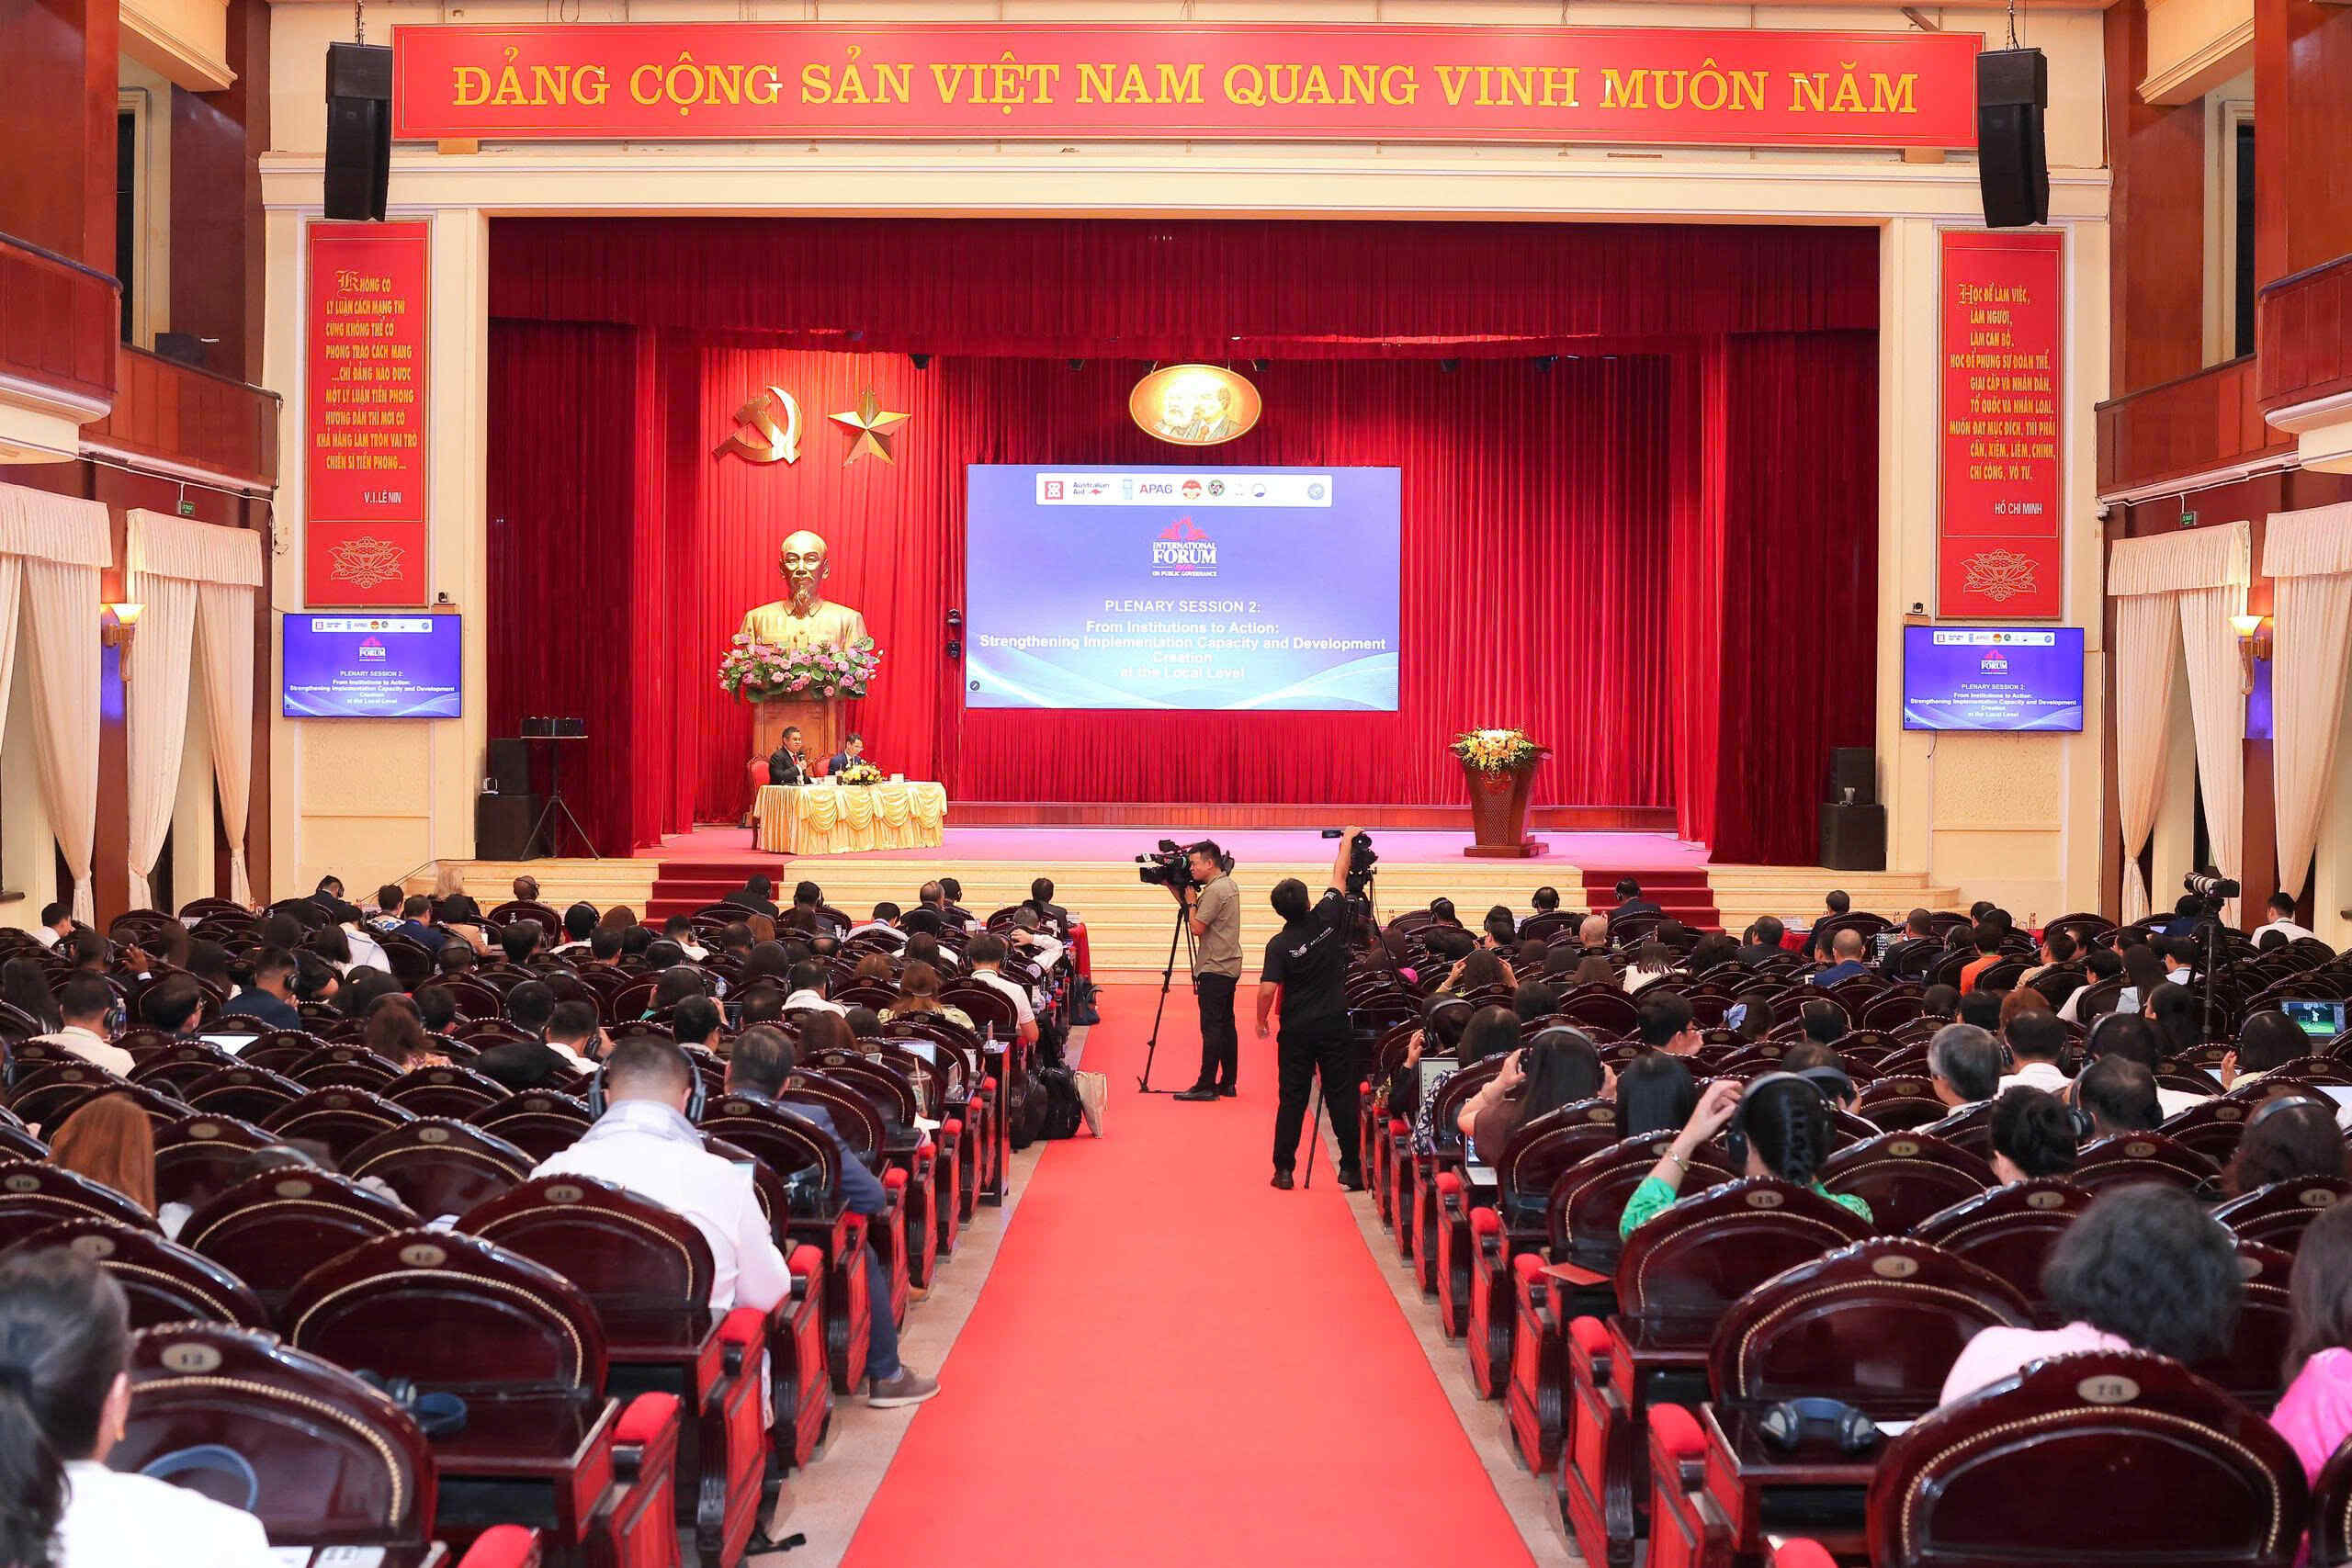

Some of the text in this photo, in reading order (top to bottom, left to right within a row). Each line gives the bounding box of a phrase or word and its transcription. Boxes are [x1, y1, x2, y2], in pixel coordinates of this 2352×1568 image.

[453, 46, 1918, 117] ĐẢNG CỘNG SẢN VIỆT NAM QUANG VINH MUÔN NĂM
[391, 434, 402, 446] VAI
[1153, 549, 1216, 564] FORUM
[1105, 600, 1261, 613] PLENARY SESSION 2:
[1086, 621, 1280, 634] From Institutions to Action:
[979, 635, 1387, 651] Strengthening Implementation Capacity and Development
